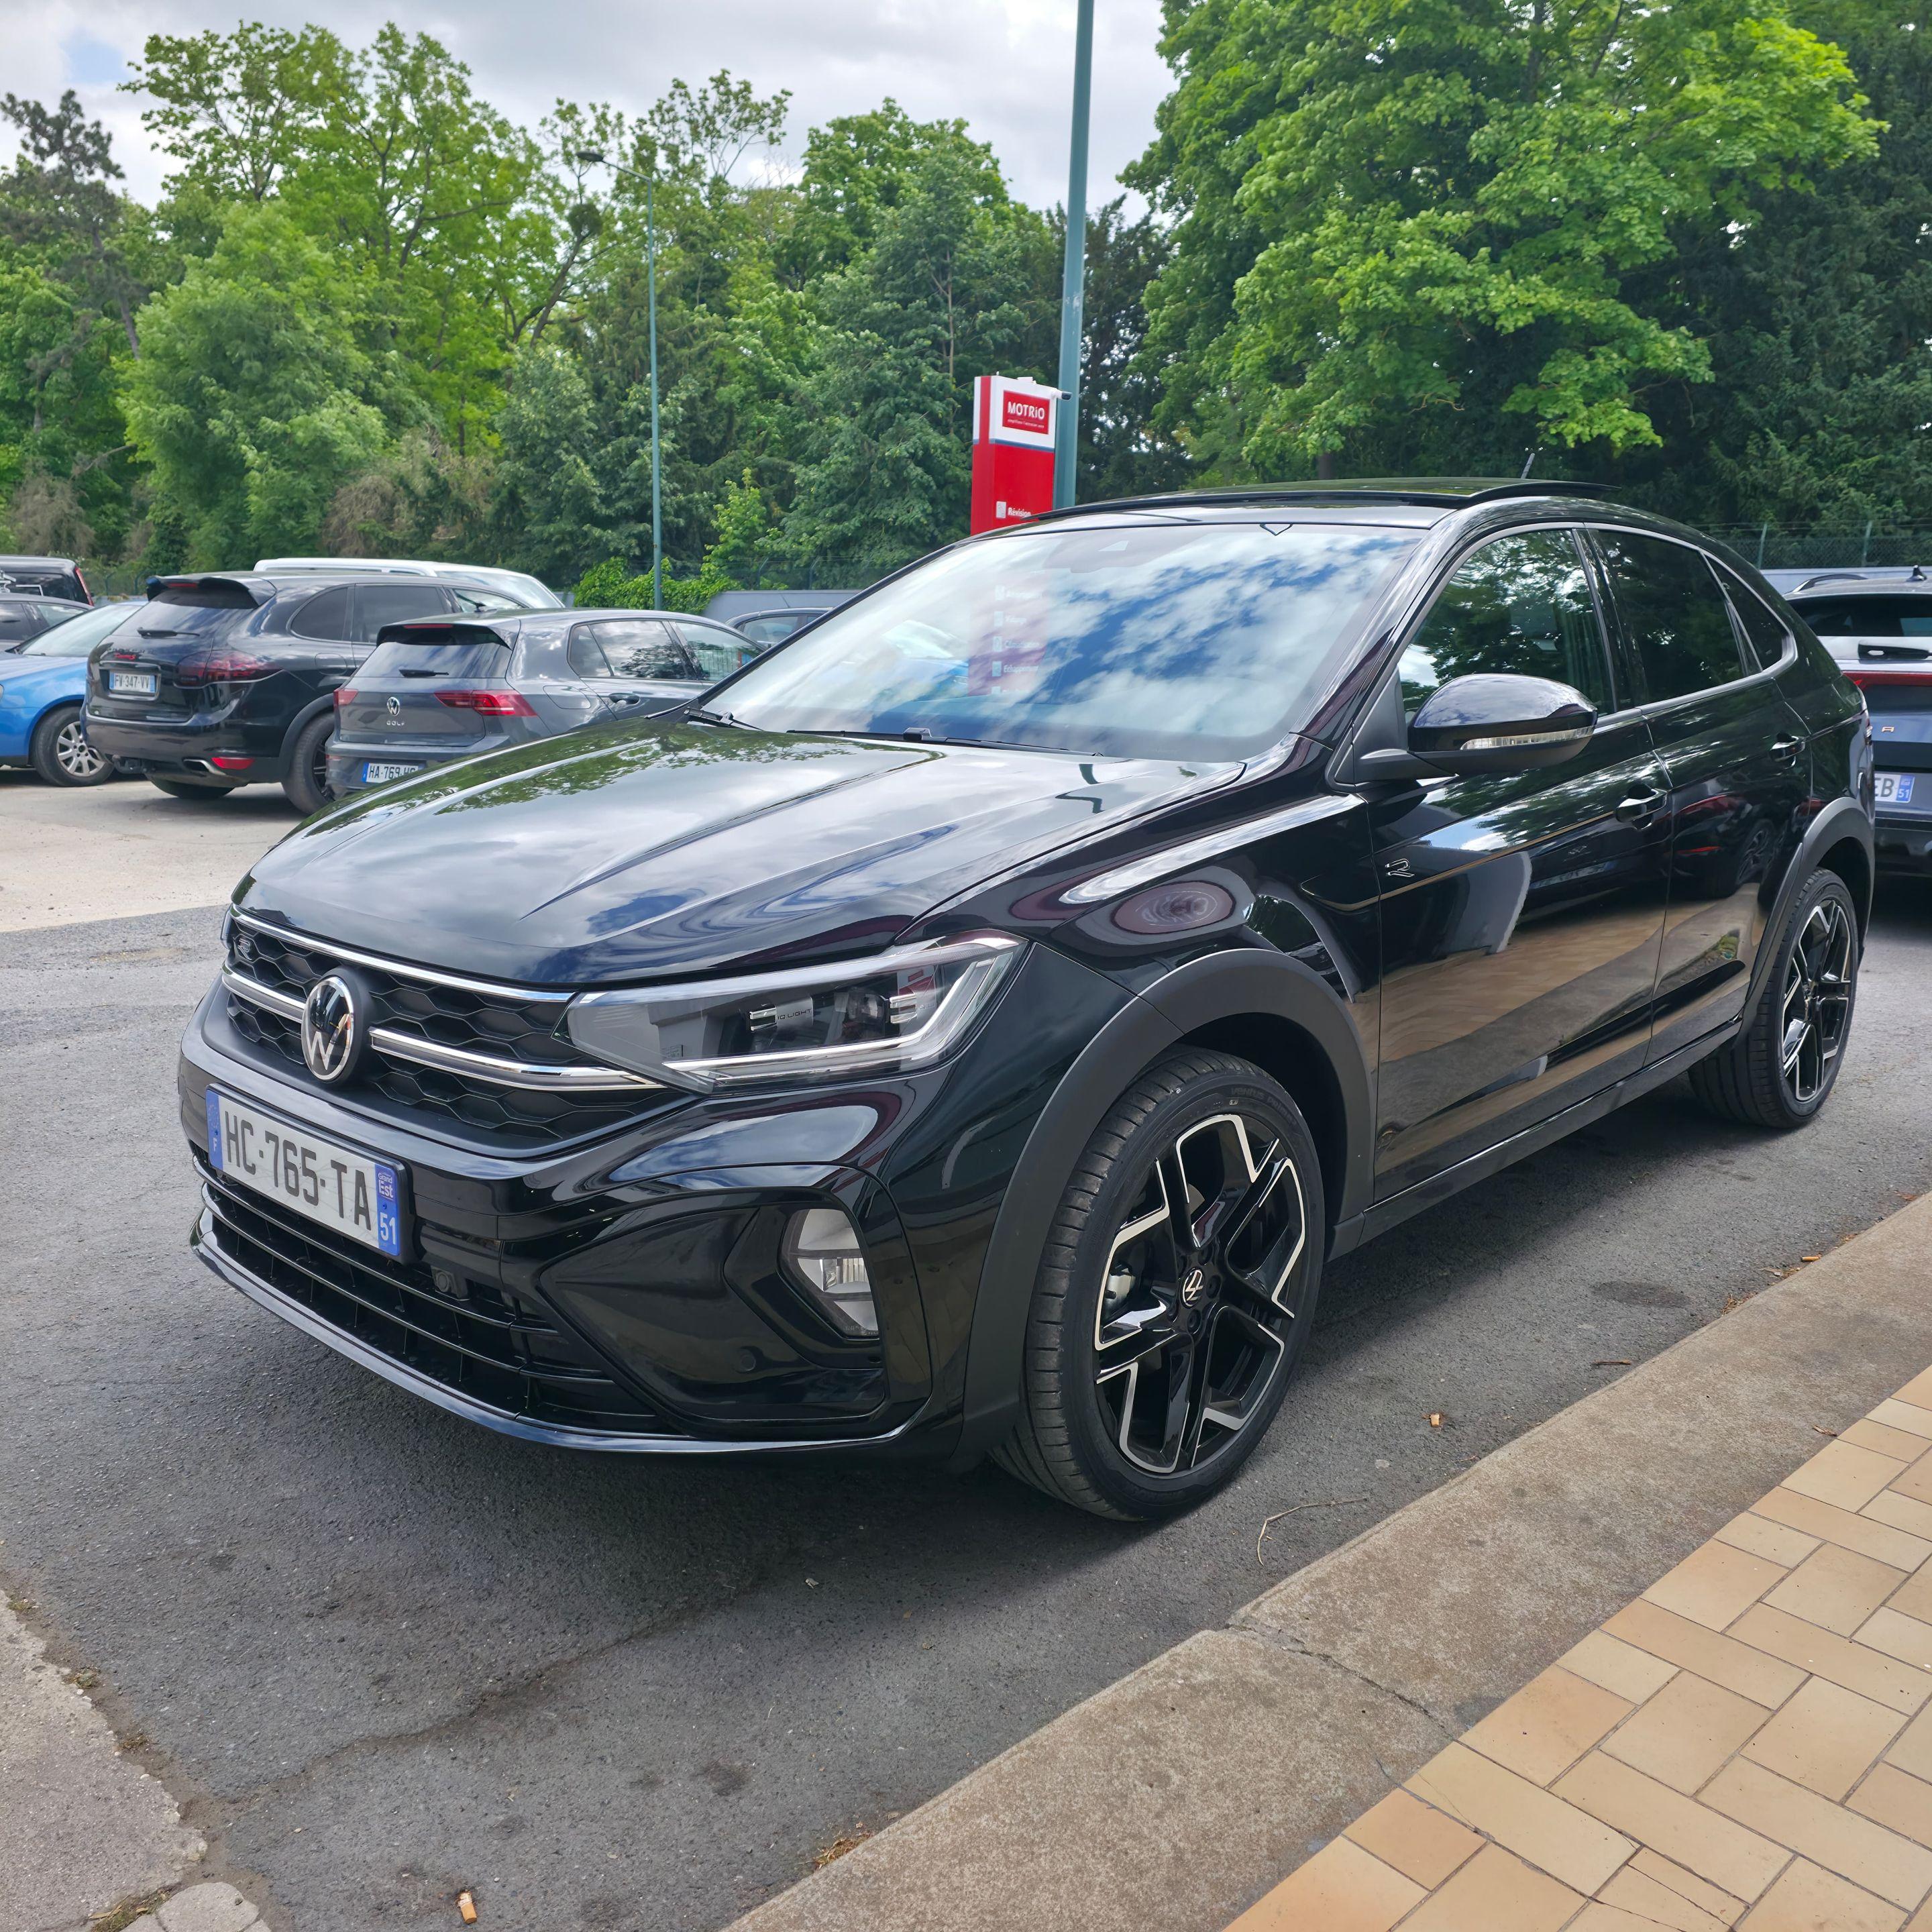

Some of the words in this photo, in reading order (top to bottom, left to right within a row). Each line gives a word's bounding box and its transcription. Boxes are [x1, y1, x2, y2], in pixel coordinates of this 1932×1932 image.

[1008, 507, 1031, 517] Révision
[1898, 788, 1910, 798] 51
[225, 1110, 371, 1230] HC-765-TA
[378, 1173, 392, 1184] Grand
[378, 1180, 393, 1199] Est
[380, 1212, 396, 1245] 51
